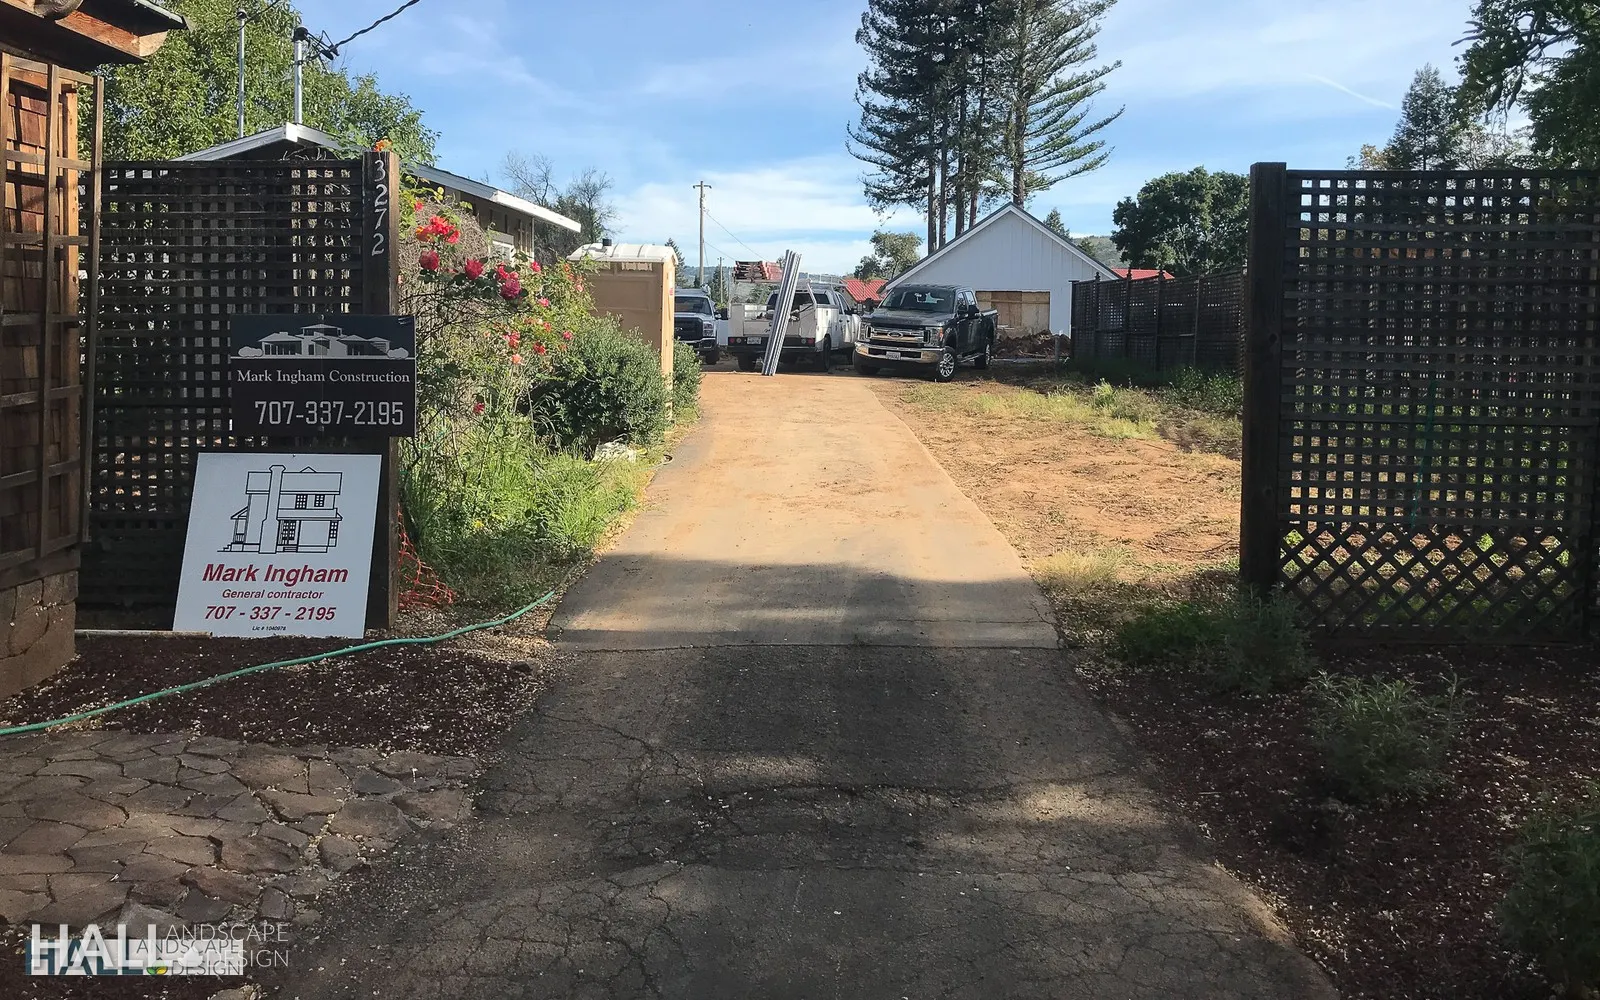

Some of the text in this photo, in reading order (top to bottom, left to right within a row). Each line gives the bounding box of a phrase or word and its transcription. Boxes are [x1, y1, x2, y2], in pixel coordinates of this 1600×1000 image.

[371, 159, 388, 257] 3272
[237, 370, 410, 384] Mark Ingham Construction
[255, 400, 404, 425] 707-337-2195
[202, 563, 348, 587] Mark Ingham
[222, 588, 324, 599] General contractor
